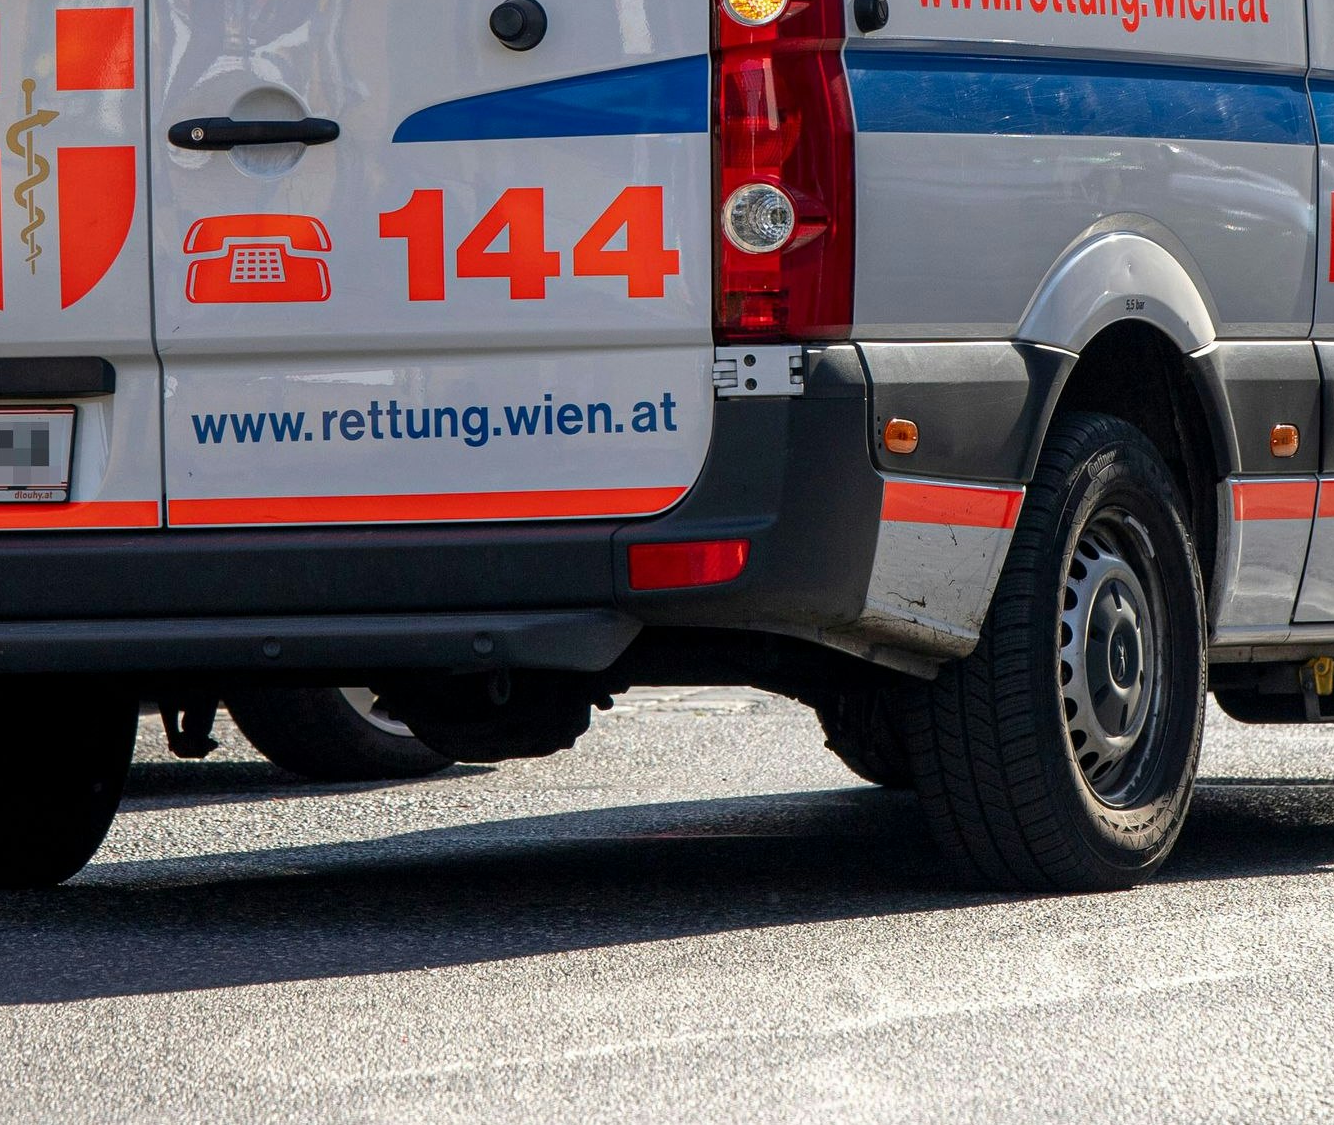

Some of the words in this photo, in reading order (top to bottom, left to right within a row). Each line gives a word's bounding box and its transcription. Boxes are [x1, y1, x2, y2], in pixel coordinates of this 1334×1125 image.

[378, 185, 680, 302] 144
[191, 391, 678, 448] www.rettung.wien.at
[14, 490, 54, 501] dlouhy.at
